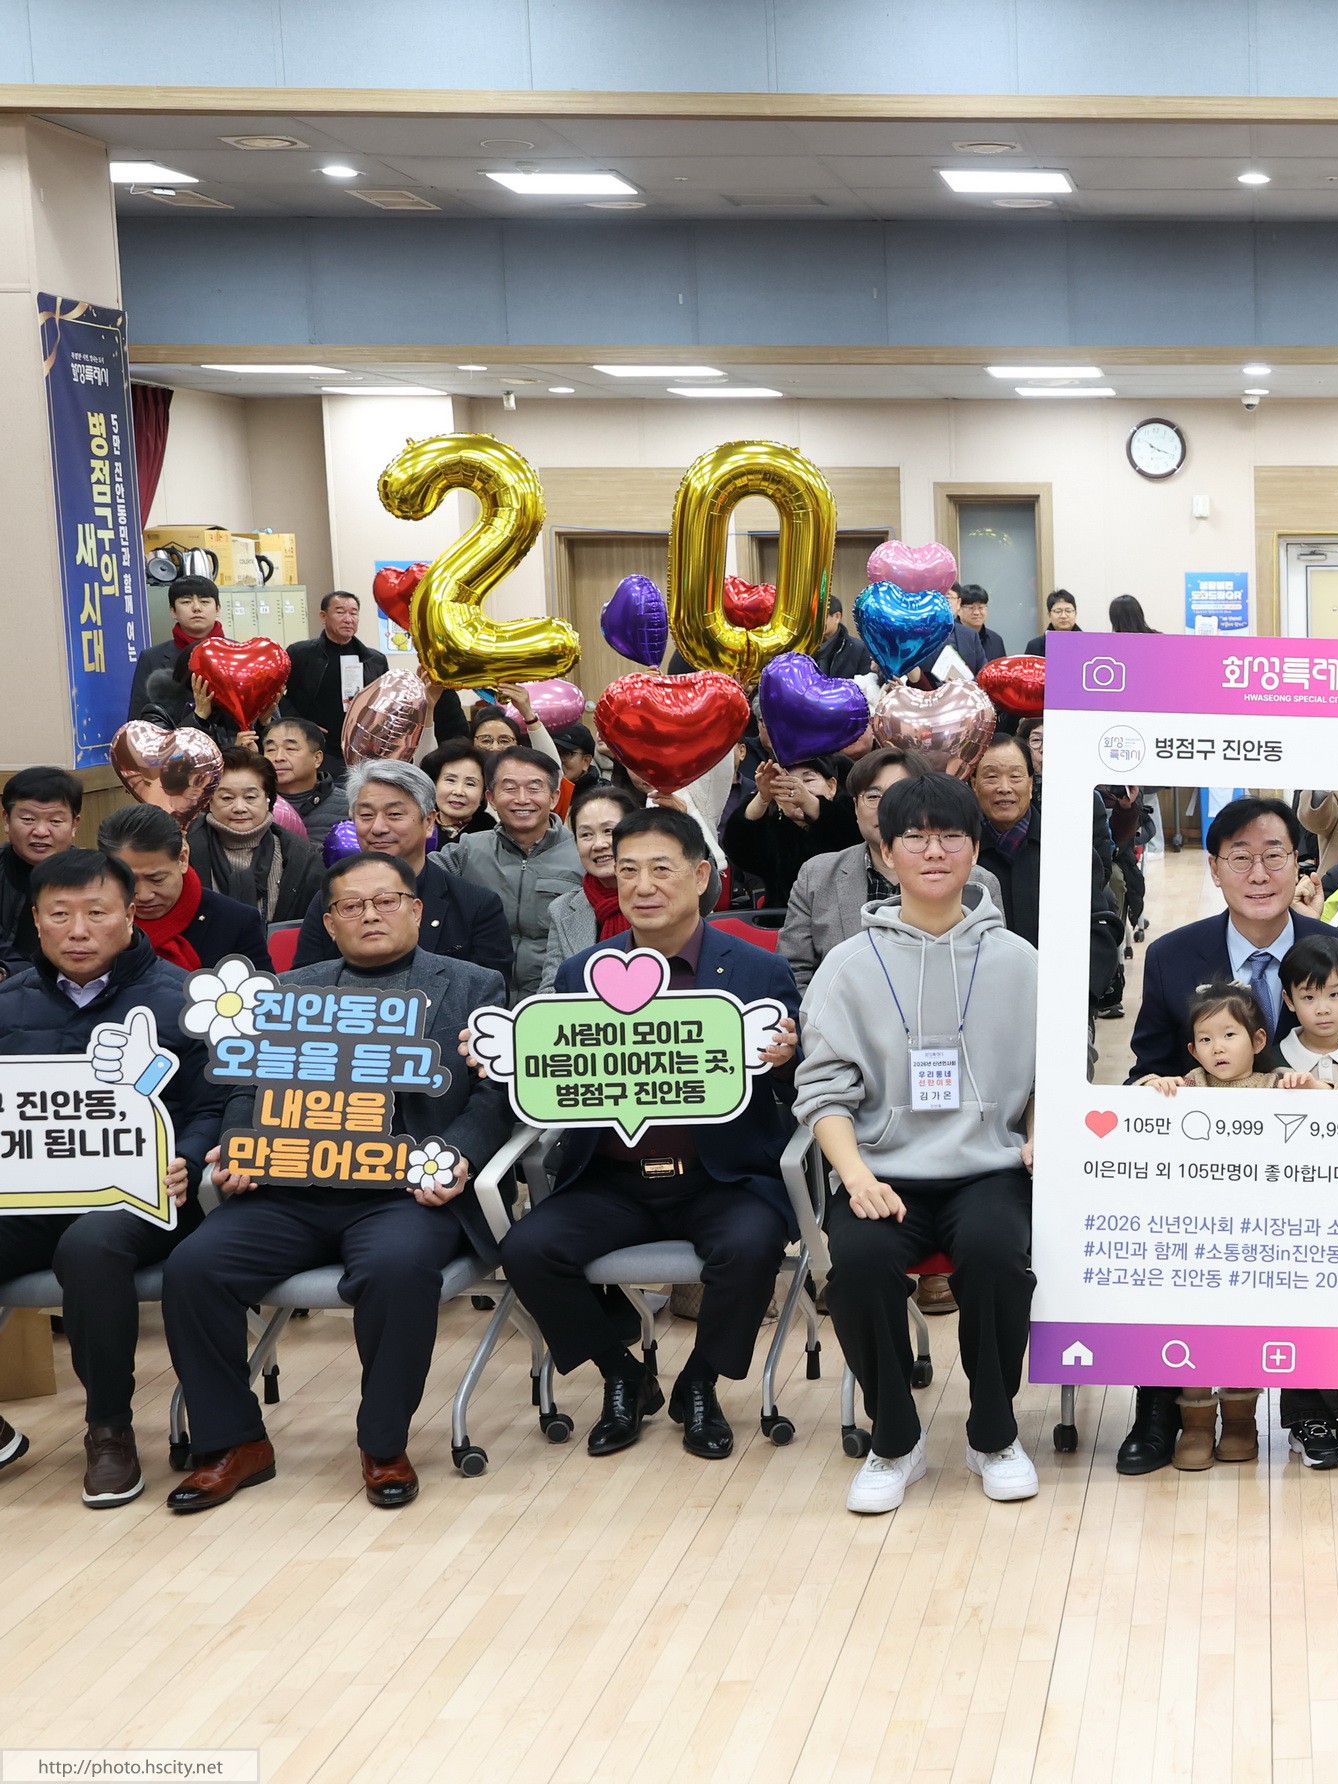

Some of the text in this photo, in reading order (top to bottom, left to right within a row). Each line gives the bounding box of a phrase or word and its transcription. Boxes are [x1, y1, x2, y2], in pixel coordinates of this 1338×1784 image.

[86, 411, 120, 597] 병점구의
[110, 413, 137, 663] 5만 진안동민과 함께 여는
[76, 523, 106, 673] 새 시대
[1244, 693, 1292, 703] HWASEONG
[1293, 695, 1327, 704] SPECIAL
[1155, 737, 1216, 761] 병점구
[1222, 739, 1283, 762] 진안동
[253, 991, 419, 1037] 진안동의
[553, 1020, 704, 1048] 사람이 모이고
[212, 1038, 443, 1089] 오늘을 듣고,
[525, 1049, 735, 1078] 마음이 이어지는 곳,
[918, 1070, 951, 1078] 우리동네
[16, 1090, 127, 1122] 진안동,
[556, 1080, 706, 1108] 병점구 진안동
[920, 1090, 951, 1101] 김가온
[260, 1088, 386, 1133] 내일을
[1123, 1117, 1172, 1136] 105만
[1215, 1119, 1264, 1138] 9,999
[1, 1127, 147, 1160] 게 됩니다
[227, 1136, 408, 1181] 만들어요!
[1084, 1160, 1149, 1180] 이은미님
[1155, 1162, 1171, 1180] 외
[1178, 1163, 1258, 1182] 105만명이
[1084, 1214, 1141, 1232] #2026
[1147, 1215, 1234, 1235] 신년인사회
[1240, 1217, 1322, 1237] #시장님과
[1083, 1241, 1148, 1260] #시민과
[1154, 1241, 1188, 1261] 함께
[1083, 1267, 1164, 1287] #살고싶은
[1171, 1268, 1223, 1288] 진안동
[1228, 1270, 1310, 1289] #기대되는
